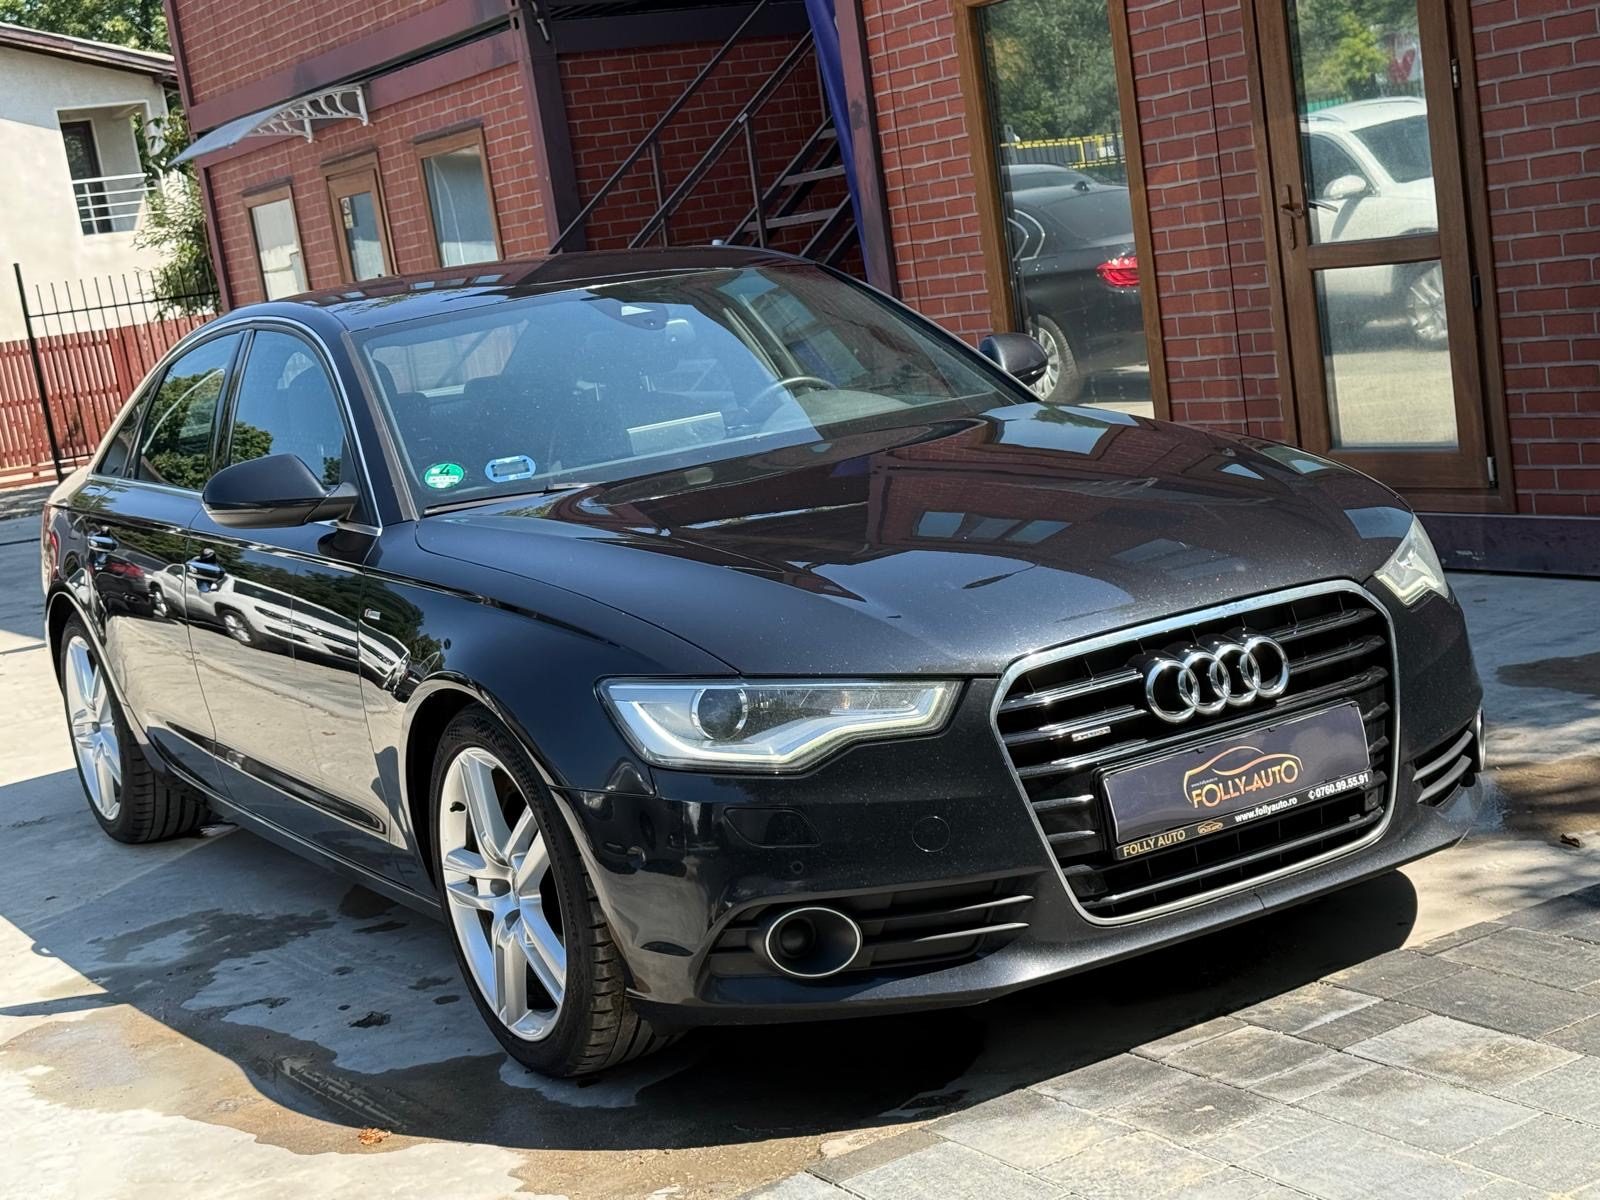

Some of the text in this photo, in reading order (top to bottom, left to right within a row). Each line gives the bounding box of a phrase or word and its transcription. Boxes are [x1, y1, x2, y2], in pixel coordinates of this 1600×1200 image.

[1315, 772, 1369, 798] 0760.99.55.91
[1234, 796, 1298, 822] www.follyauto.ro
[1123, 829, 1186, 857] FOLLY AUTO
